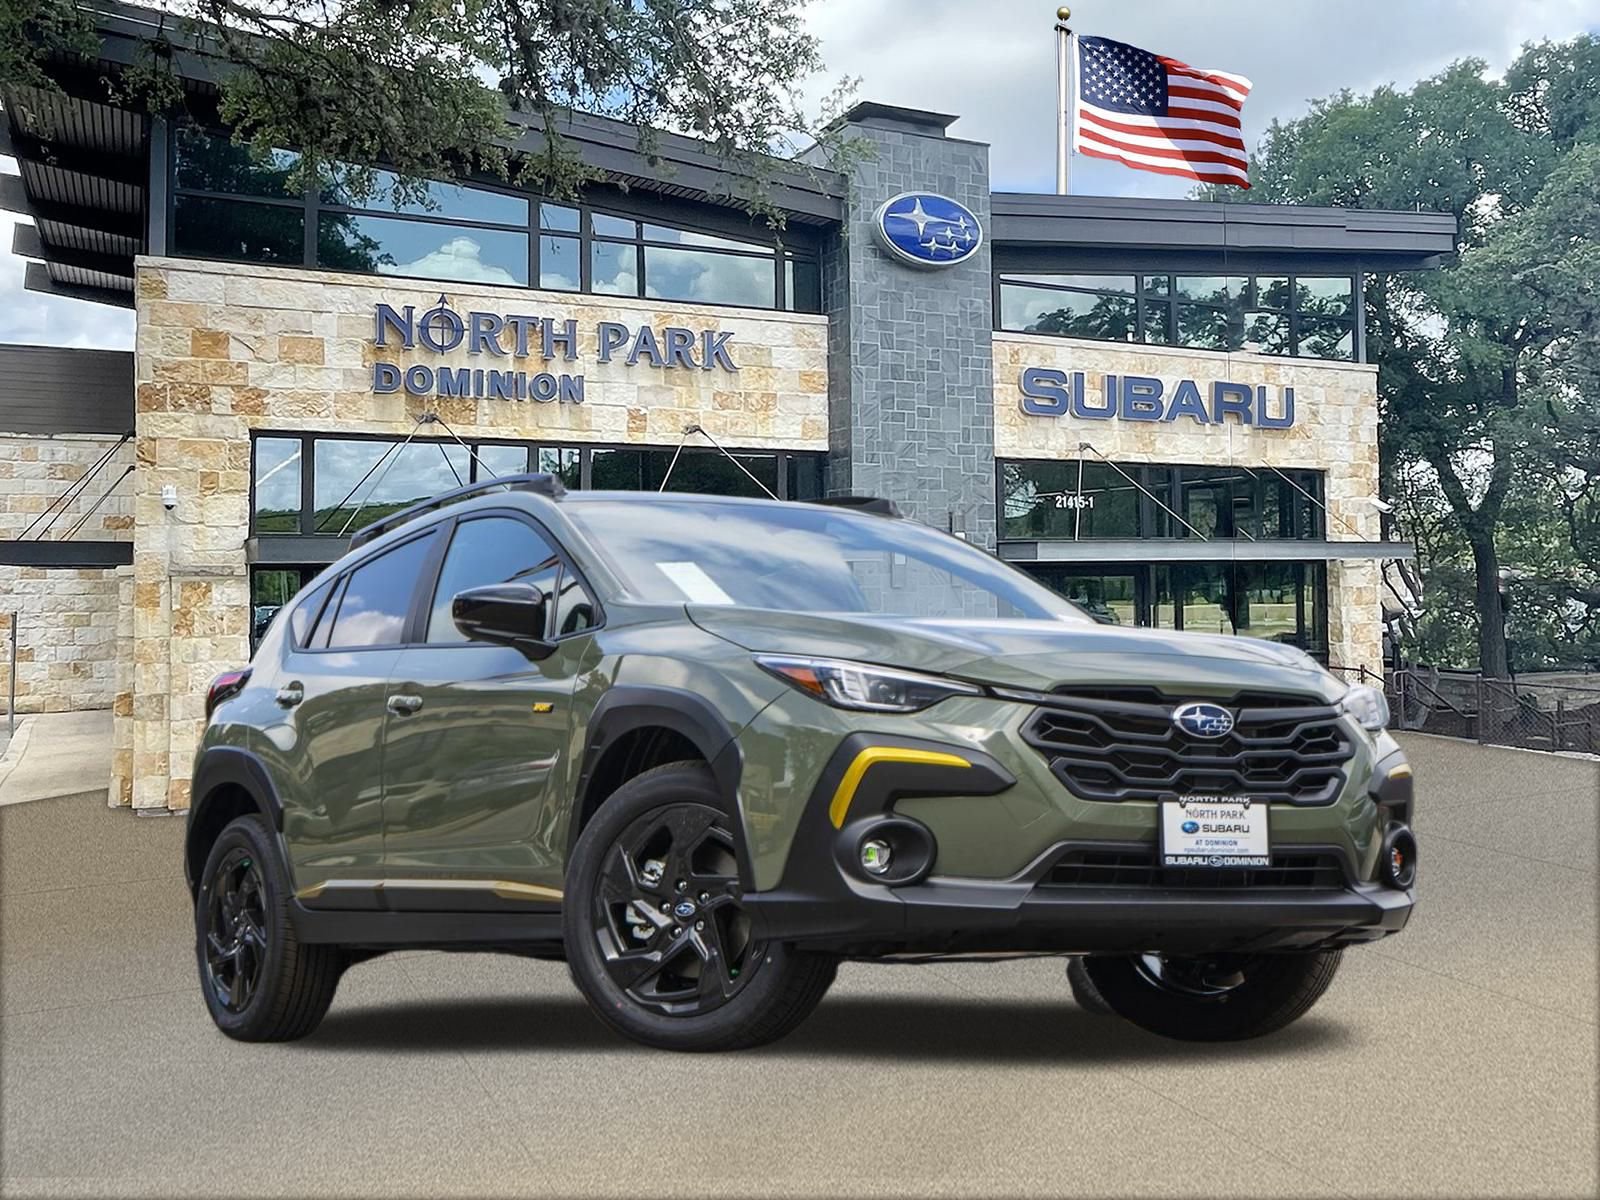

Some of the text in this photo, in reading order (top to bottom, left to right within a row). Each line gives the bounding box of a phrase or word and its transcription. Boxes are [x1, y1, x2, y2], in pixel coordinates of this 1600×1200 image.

[375, 293, 741, 372] NORTH PARK
[373, 362, 585, 403] DOMINION
[1019, 367, 1295, 429] SUBARU
[1179, 795, 1251, 805] NORTH PARK
[1185, 809, 1246, 820] NORTH PARK
[1202, 823, 1250, 833] SUBARU
[1165, 856, 1269, 866] SUBARU DOMINION
